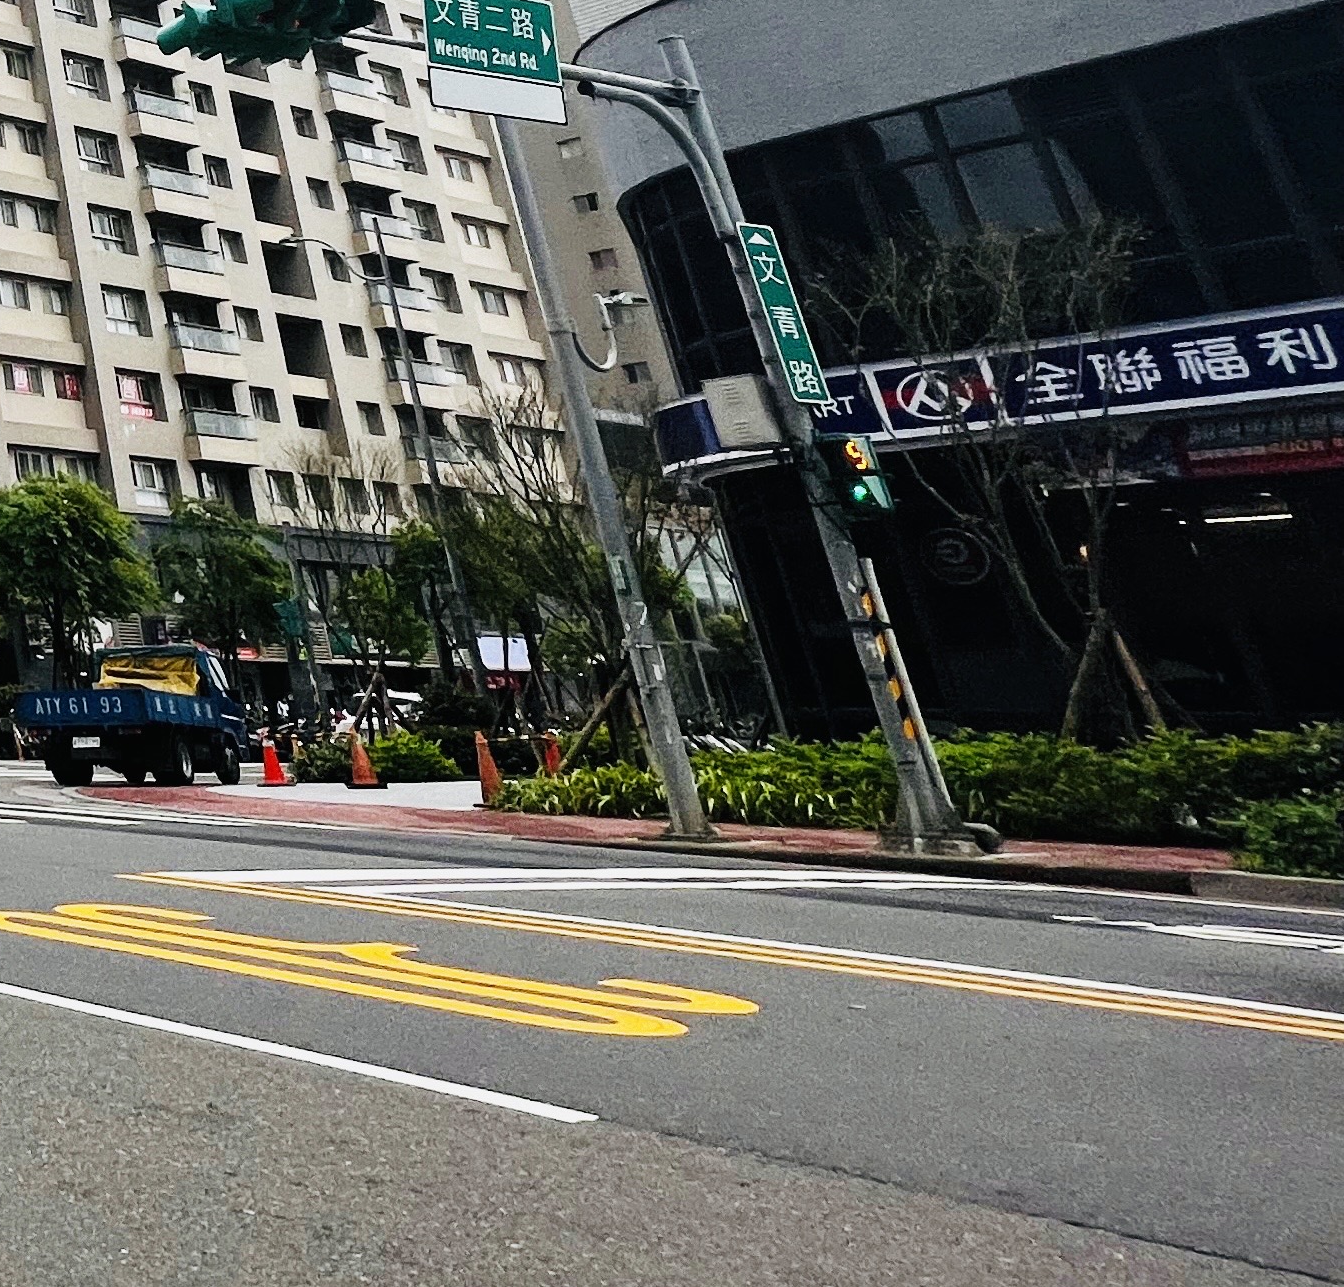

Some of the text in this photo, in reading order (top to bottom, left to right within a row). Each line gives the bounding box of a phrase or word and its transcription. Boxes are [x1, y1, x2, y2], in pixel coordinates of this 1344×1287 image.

[433, 37, 488, 68] Wenqing
[491, 47, 517, 68] 2nd
[752, 251, 822, 394] 文青路
[1015, 323, 1338, 405] 全聯福利
[35, 696, 122, 715] ATY 61 93
